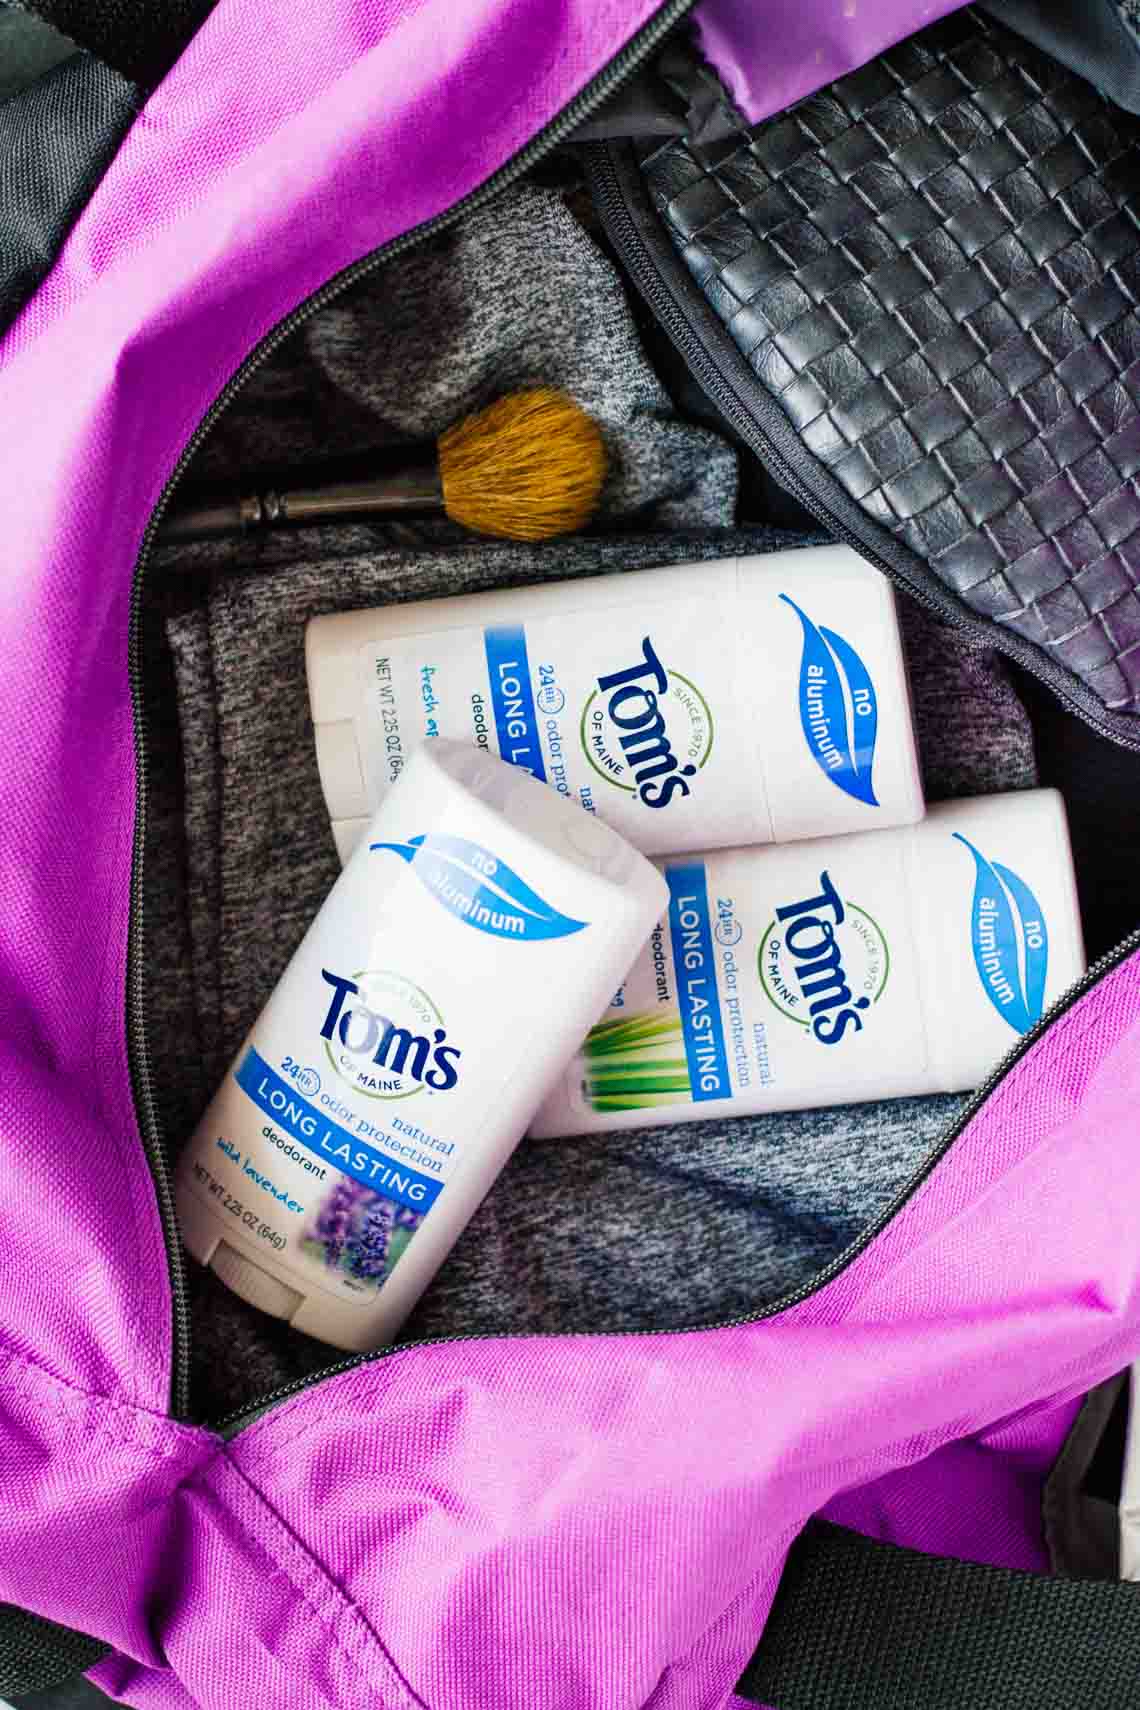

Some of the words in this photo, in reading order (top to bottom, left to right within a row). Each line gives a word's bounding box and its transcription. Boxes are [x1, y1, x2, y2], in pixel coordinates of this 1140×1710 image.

[420, 663, 440, 714] fresh
[498, 661, 529, 739] LONG
[806, 663, 844, 769] aluminum
[853, 687, 873, 717] no
[546, 719, 563, 759] odor
[591, 710, 605, 732] OF
[597, 634, 691, 809] Tom's
[673, 687, 700, 726] SINCE
[689, 729, 706, 759] 1970
[591, 734, 625, 777] MAINE
[471, 851, 498, 877] no
[677, 895, 706, 970] LONG
[768, 939, 781, 960] OF
[775, 869, 870, 1045] Tom's
[978, 896, 1016, 1006] aluminum
[1024, 920, 1045, 950] no
[722, 951, 739, 992] odor
[767, 963, 799, 1007] MAINE
[319, 967, 461, 1092] Tom's
[687, 978, 721, 1092] LASTING
[725, 997, 752, 1089] protection
[356, 1071, 403, 1092] MAINE
[257, 1077, 318, 1137] LONG
[320, 1130, 428, 1203] LASTING
[261, 1125, 327, 1181] deodorant
[319, 1092, 355, 1124] odor
[355, 1118, 444, 1174] protection
[391, 1116, 456, 1157] natural
[216, 1136, 241, 1166] wild
[241, 1157, 305, 1214] lavender
[257, 1222, 288, 1251] (64g)
